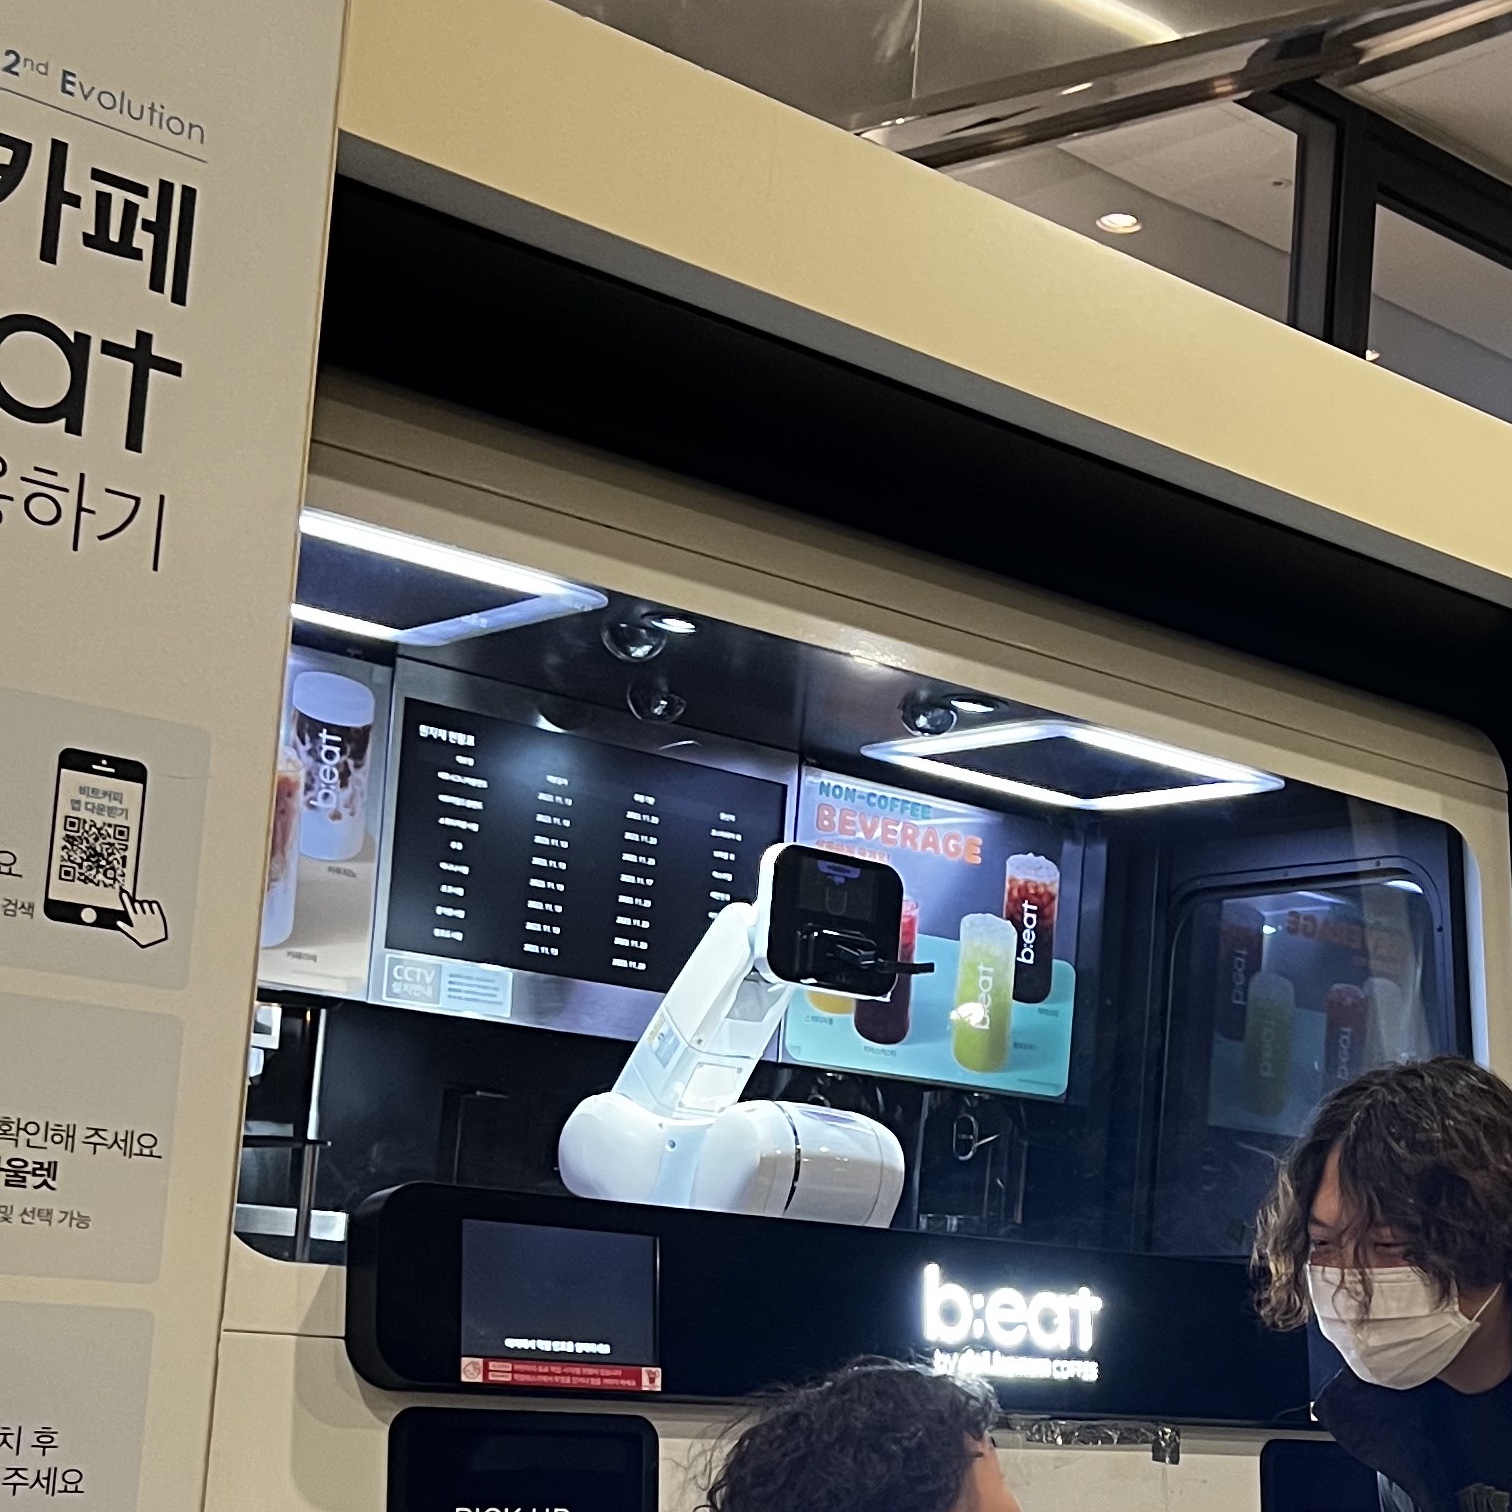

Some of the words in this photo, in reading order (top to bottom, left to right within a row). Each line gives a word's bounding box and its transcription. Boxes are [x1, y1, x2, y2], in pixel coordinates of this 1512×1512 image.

[2, 48, 50, 79] 2nd
[60, 68, 206, 145] Evolution
[0, 455, 166, 573] 하기
[818, 780, 933, 820] NON-COFFEE
[815, 802, 984, 866] BEVERAGE
[1016, 900, 1039, 965] b:eat
[392, 963, 436, 985] CCTV
[81, 1126, 163, 1160] 주세요
[0, 1155, 59, 1191] 울렛
[18, 1205, 54, 1227] 선택
[57, 1210, 92, 1230] 가능
[922, 1261, 1103, 1352] b:eat
[30, 1426, 59, 1457] 후
[1, 1466, 85, 1498] 주세요
